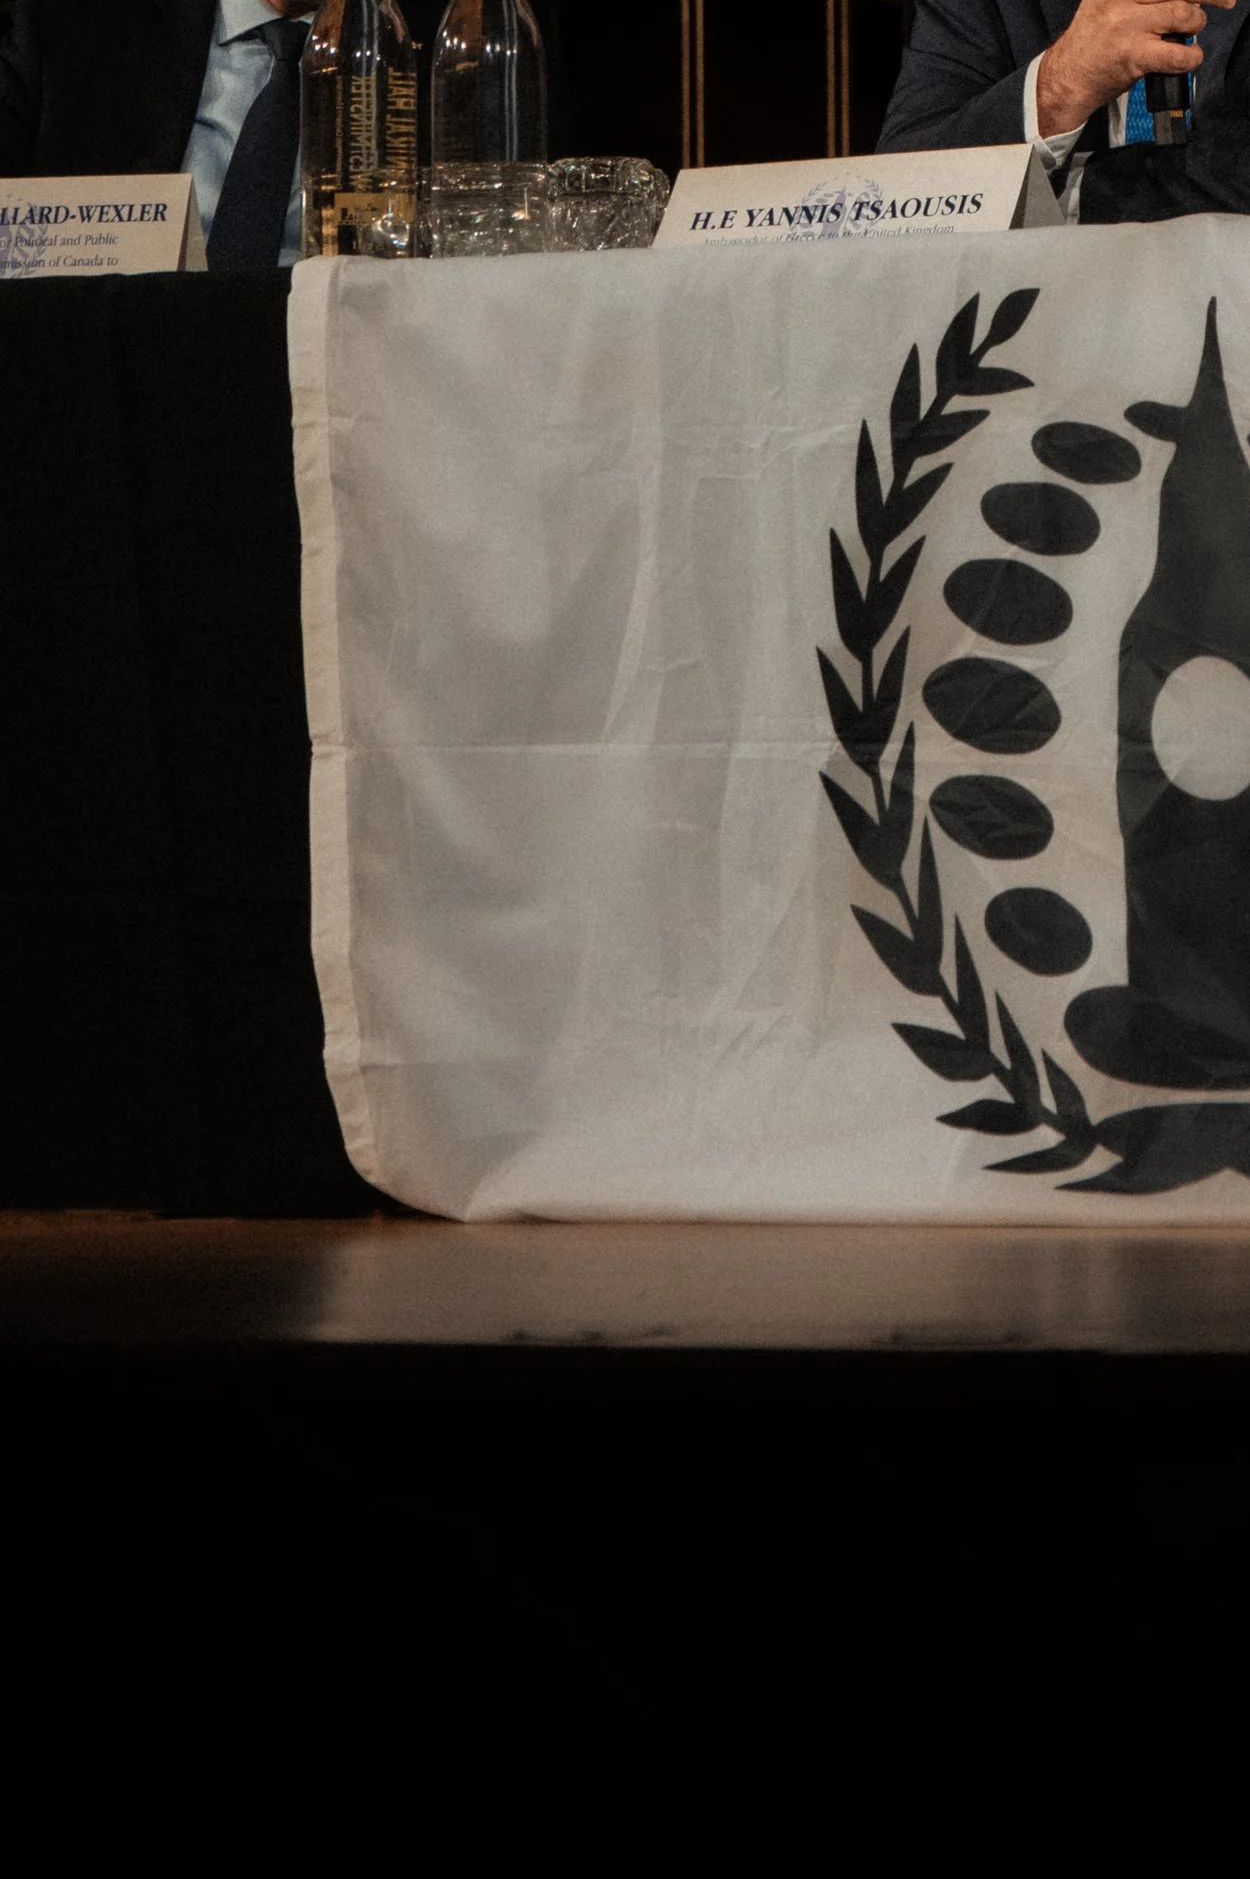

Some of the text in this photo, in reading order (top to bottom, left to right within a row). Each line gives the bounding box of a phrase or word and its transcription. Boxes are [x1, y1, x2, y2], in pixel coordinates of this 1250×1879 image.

[690, 193, 984, 230] H.E YANNIS TSAOUSIS
[14, 234, 58, 247] Political
[60, 234, 82, 246] and
[84, 233, 118, 245] Public
[49, 255, 61, 267] of
[63, 254, 104, 267] Canada
[106, 256, 118, 266] to
